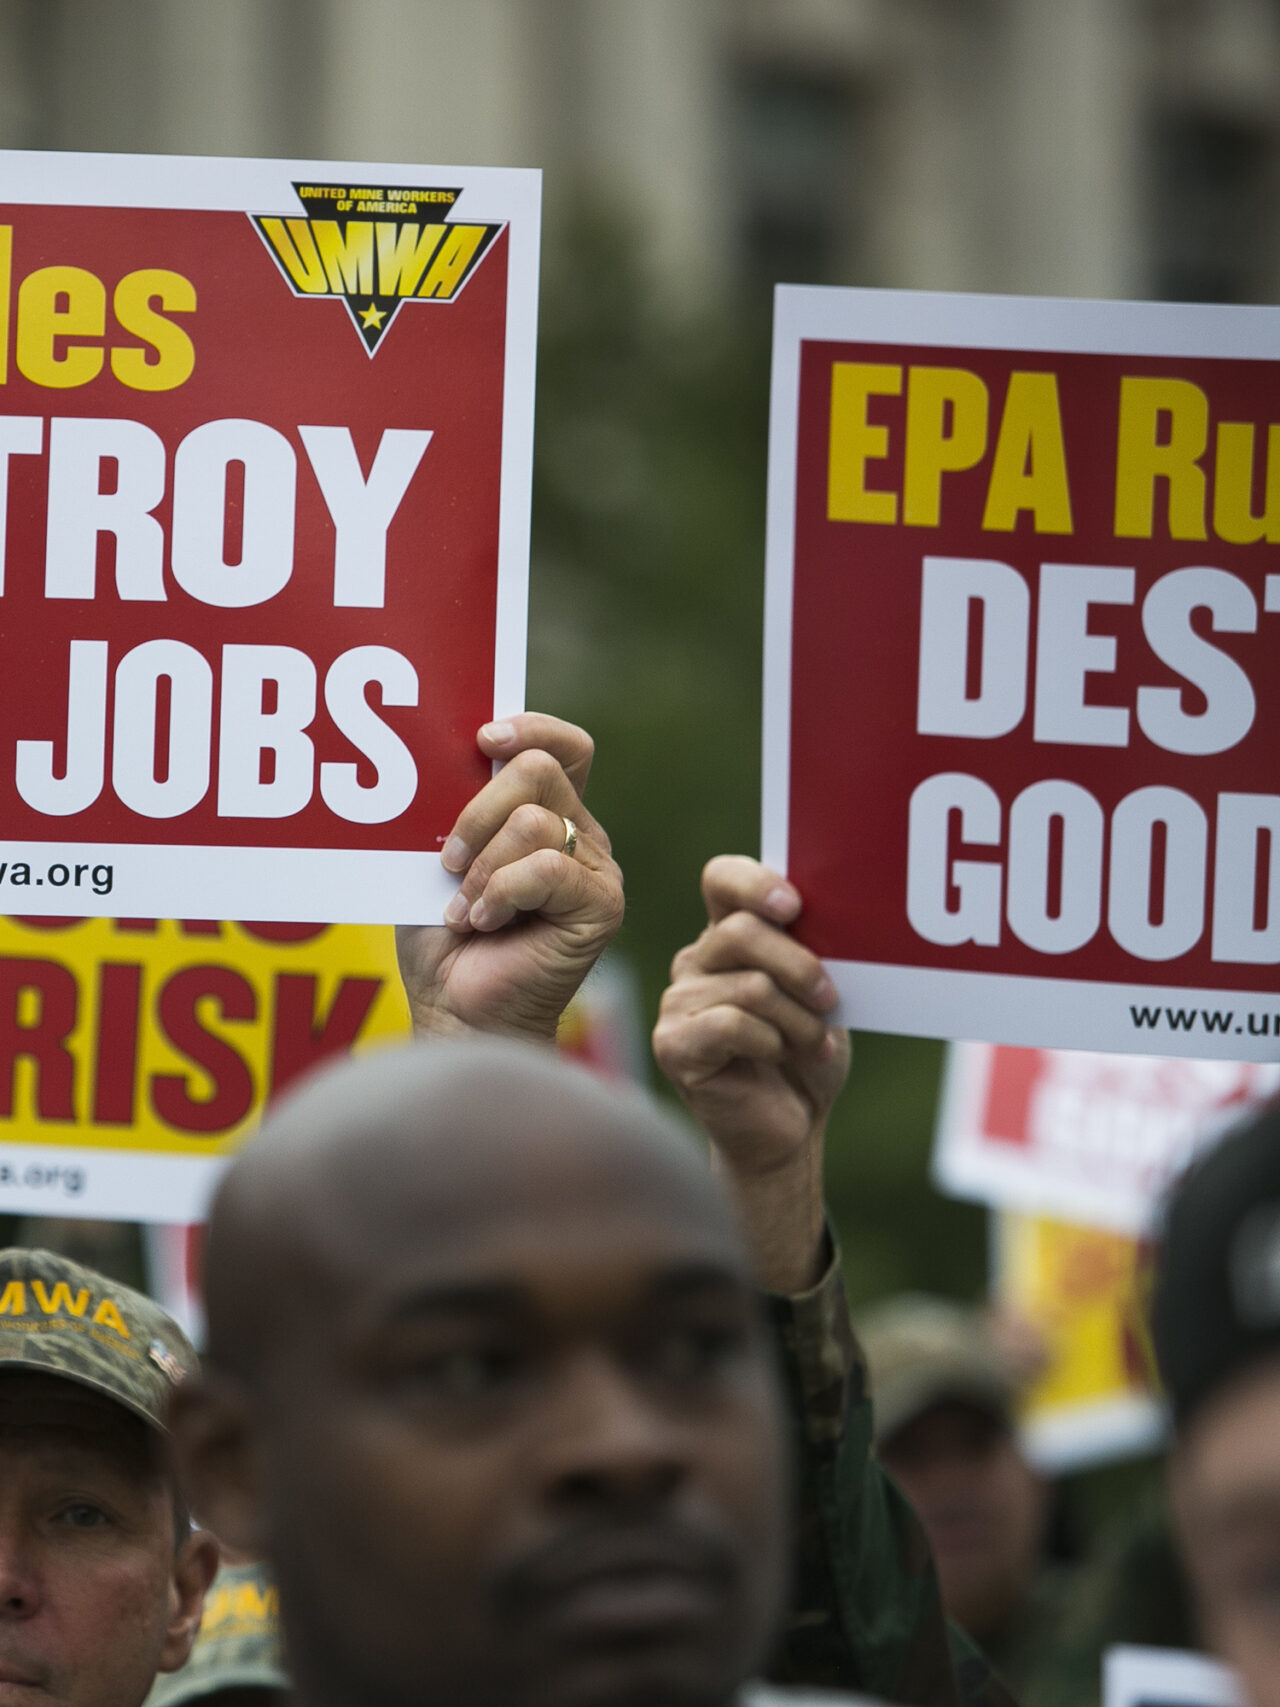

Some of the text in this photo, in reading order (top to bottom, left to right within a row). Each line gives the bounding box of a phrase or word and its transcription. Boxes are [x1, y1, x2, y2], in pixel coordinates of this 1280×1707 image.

[259, 217, 488, 298] UMWA
[299, 186, 455, 204] UNITED MINE WORKERS
[336, 200, 417, 214] OF AMERICA
[827, 361, 1074, 535] EPA
[917, 555, 1280, 755] DES
[15, 638, 420, 825] JOBS
[906, 771, 1280, 965] GOOD
[1130, 1005, 1280, 1037] www.u
